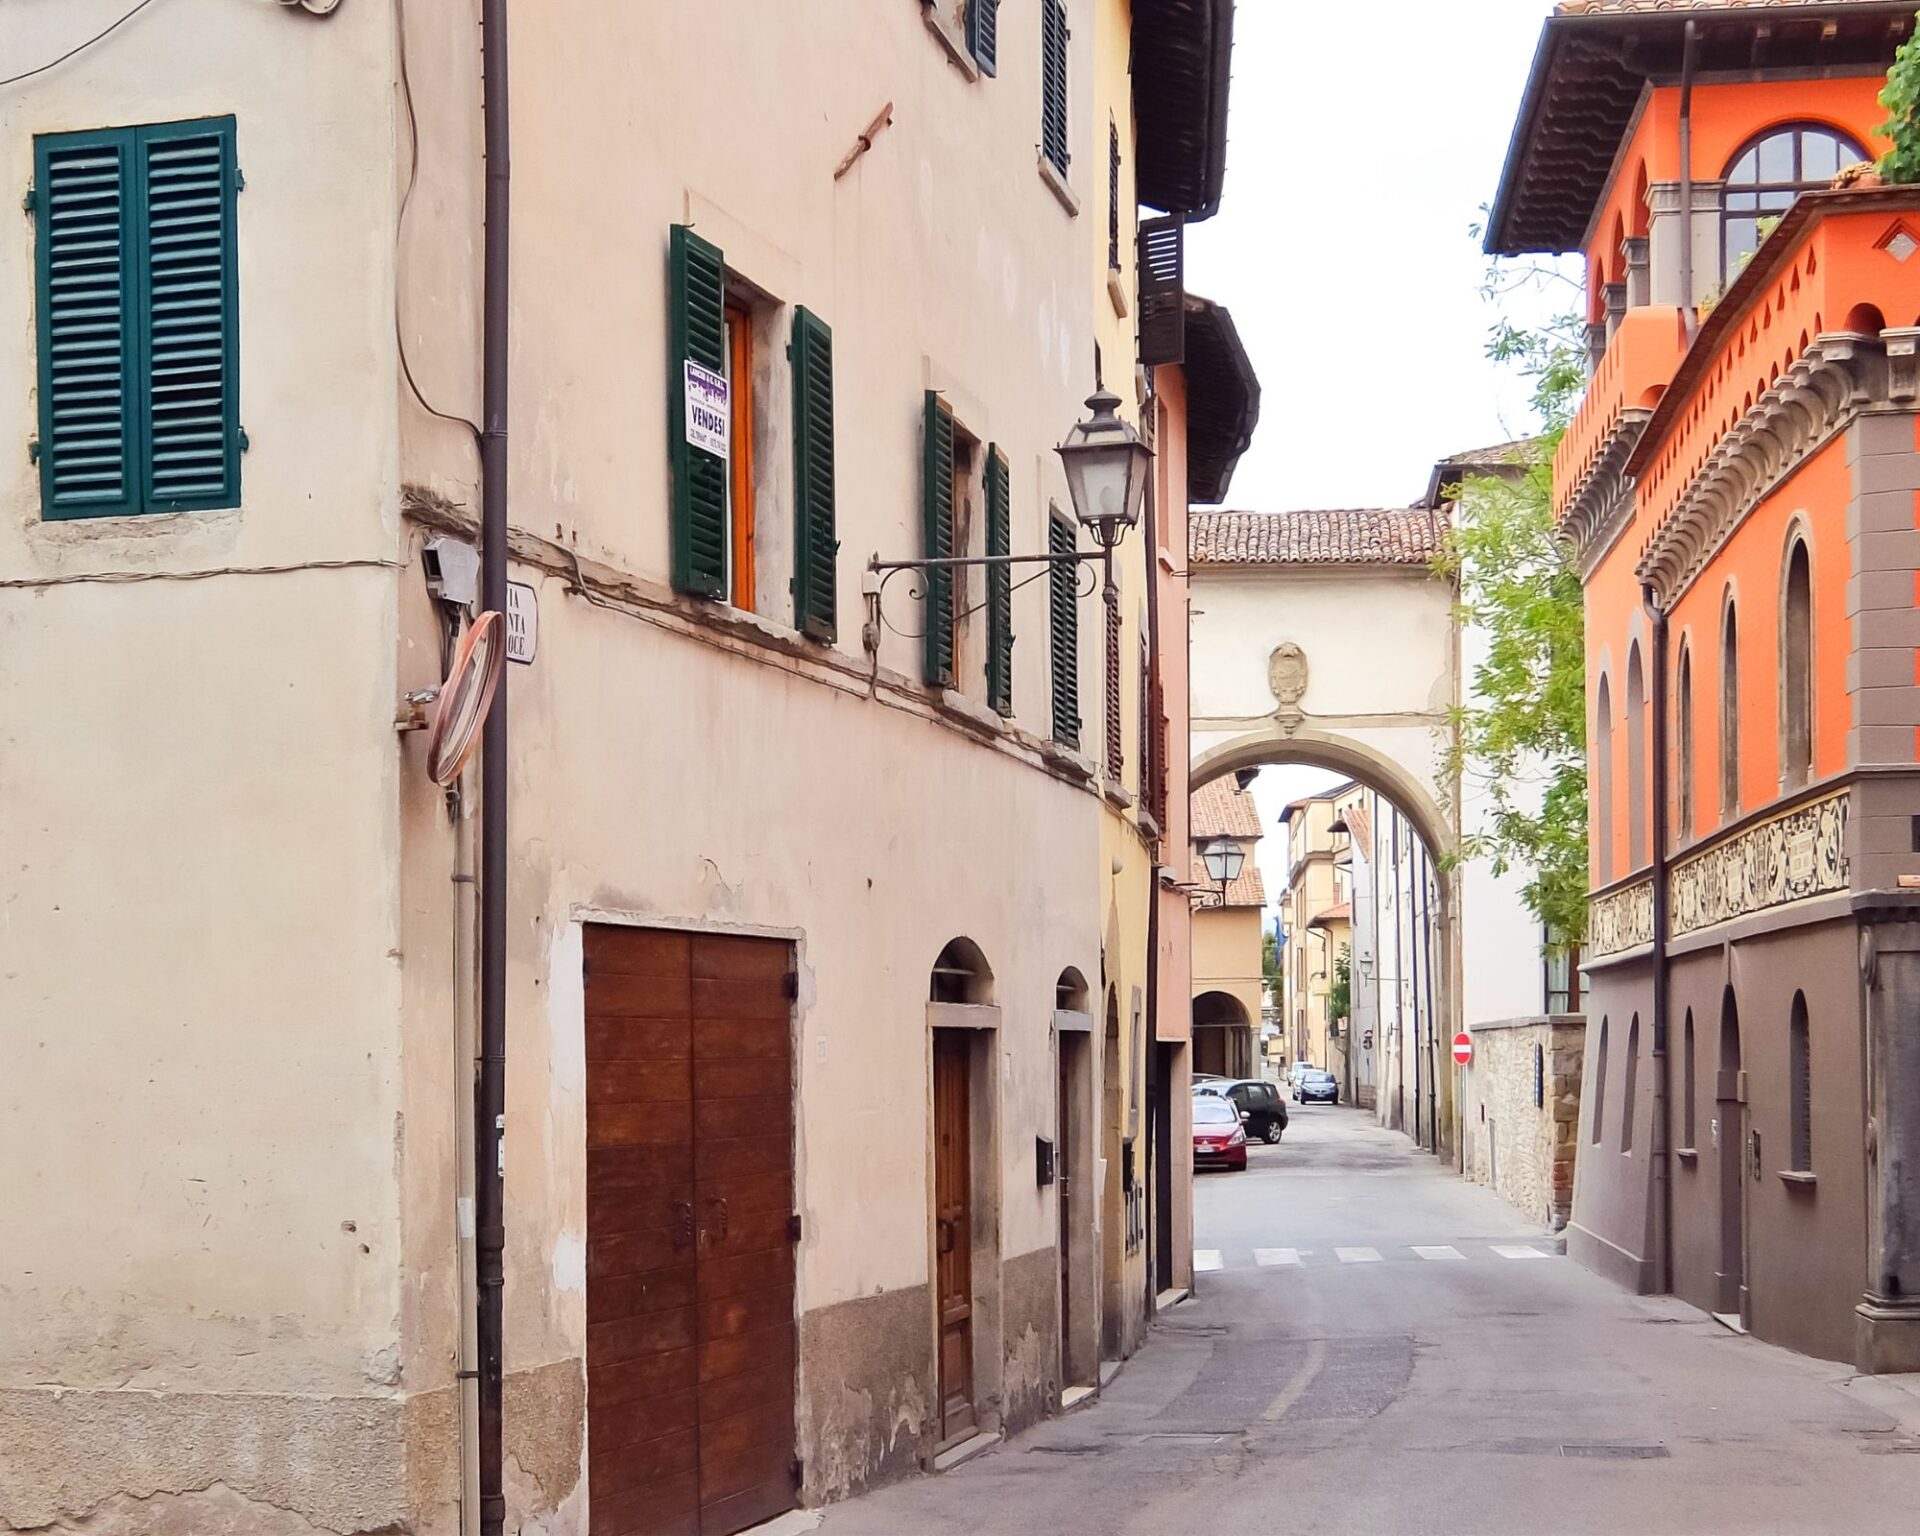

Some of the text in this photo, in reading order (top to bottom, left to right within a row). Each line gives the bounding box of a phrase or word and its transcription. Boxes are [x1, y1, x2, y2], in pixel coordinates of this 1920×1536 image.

[691, 404, 725, 437] VENDESI
[508, 588, 519, 608] IA
[508, 612, 525, 635] NTA
[508, 635, 525, 656] OCE
